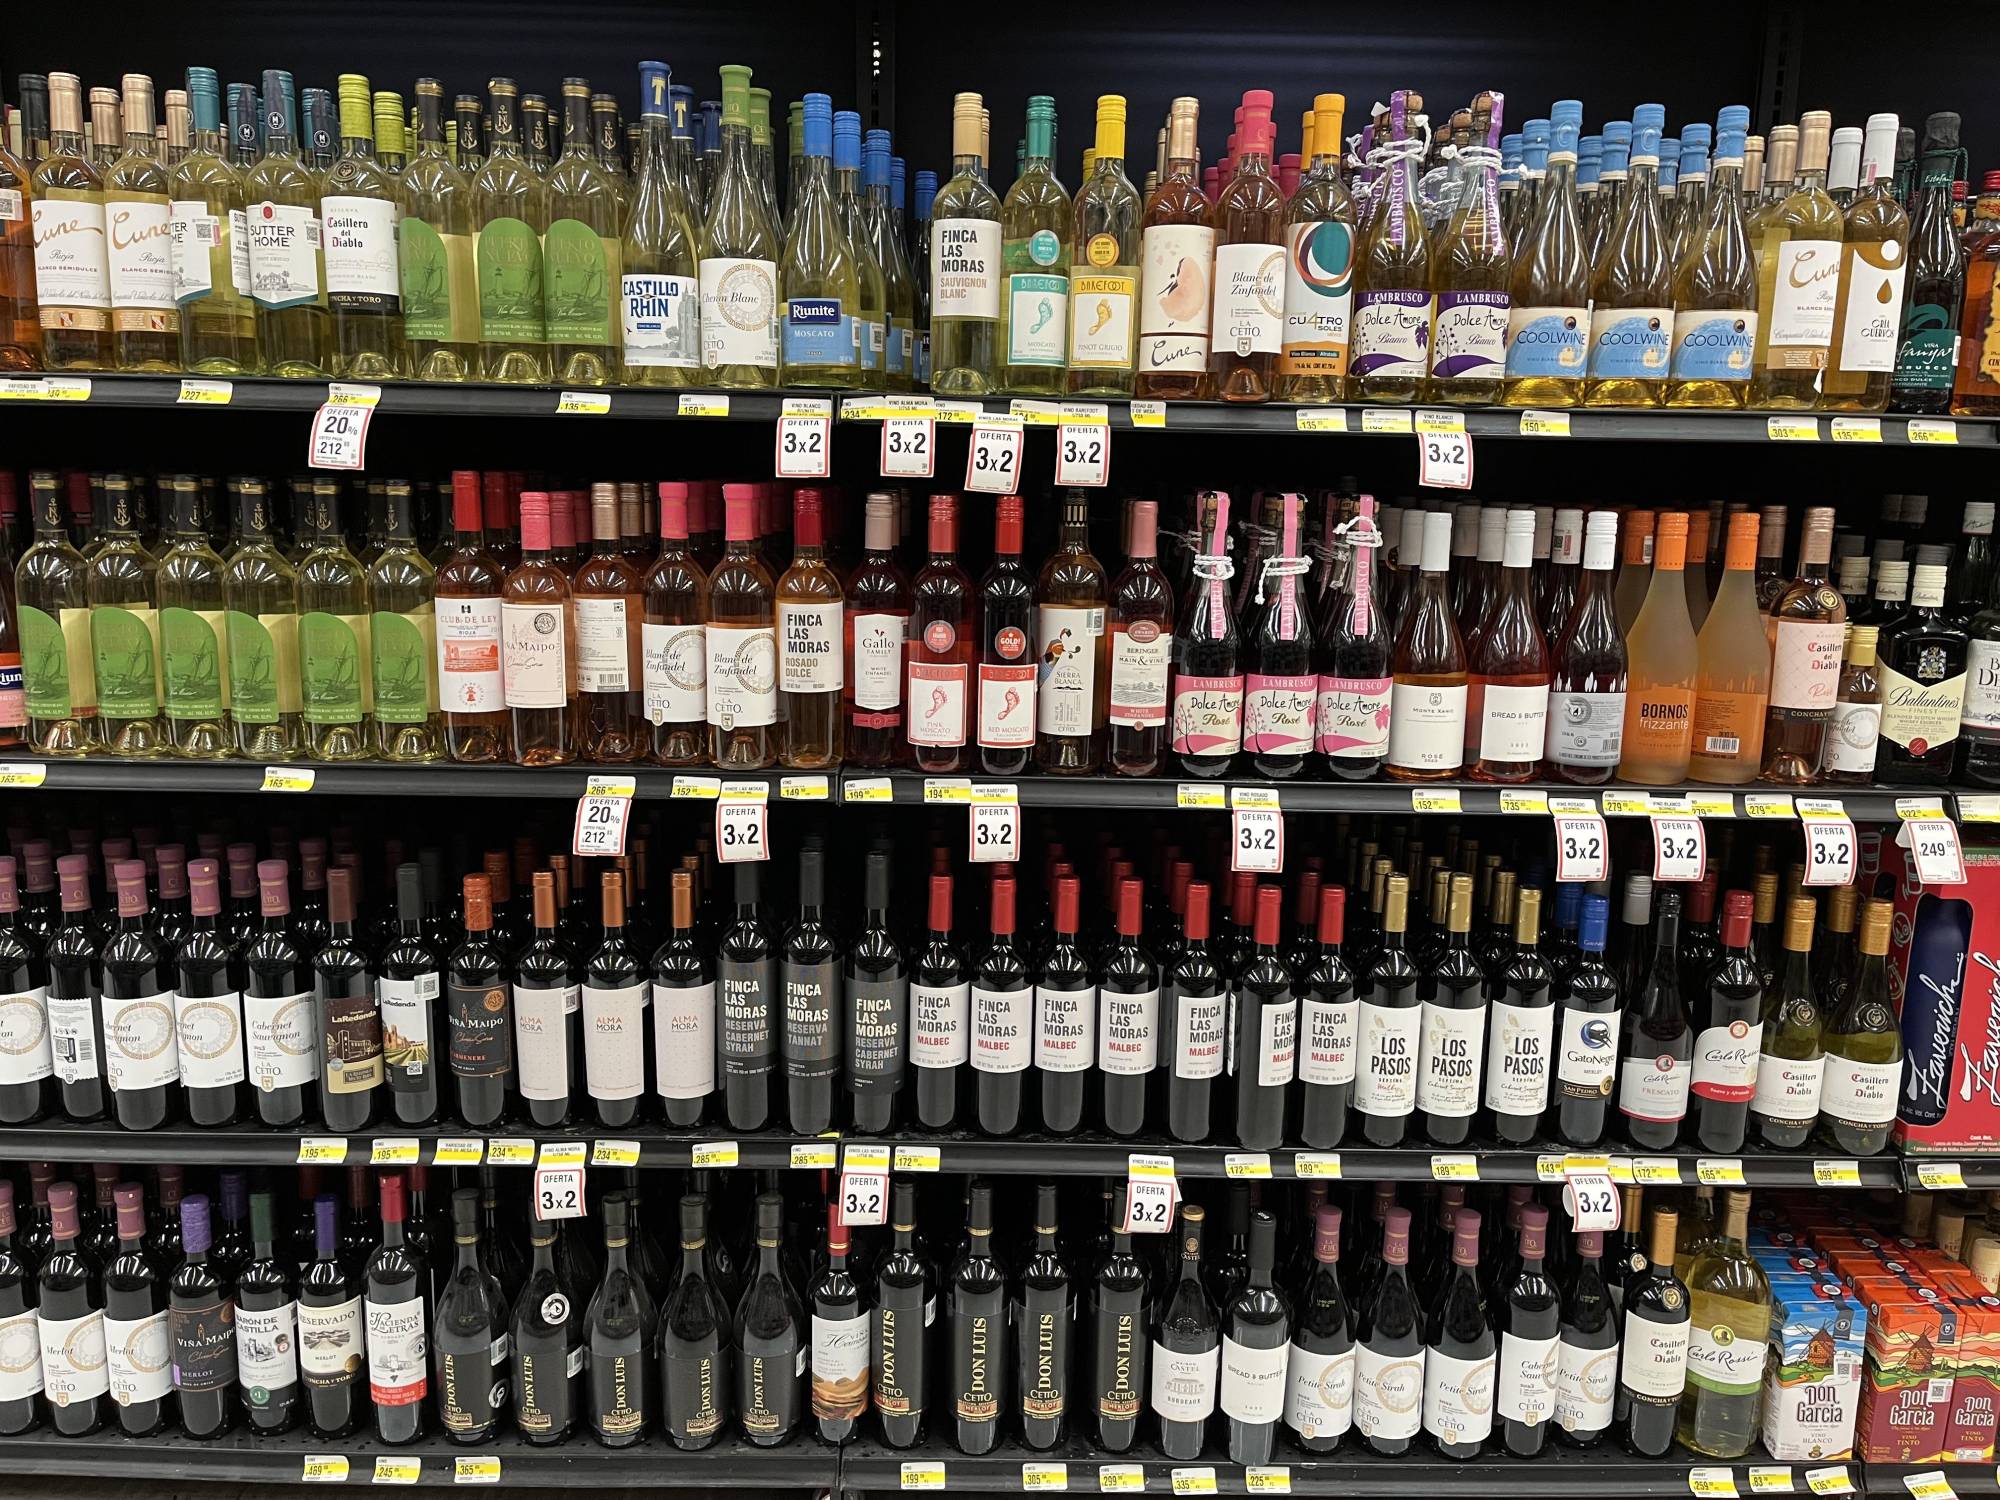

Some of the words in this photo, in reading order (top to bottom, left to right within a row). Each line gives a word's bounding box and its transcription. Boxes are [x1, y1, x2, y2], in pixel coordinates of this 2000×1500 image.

[328, 217, 368, 229] Casillero
[251, 225, 294, 236] SUTTER
[942, 230, 977, 243] FINCA
[255, 237, 289, 247] HOME
[333, 238, 363, 247] Diablo
[942, 245, 962, 257] LAS
[941, 260, 984, 272] MORAS
[940, 277, 986, 288] SAUVIGNON
[1080, 281, 1125, 291] BAREFOOT
[624, 281, 678, 297] CASTILLO
[941, 289, 966, 299] BLANC
[1368, 293, 1422, 302] LAMBRUSCO
[1457, 294, 1508, 304] LAMBRUSCO
[630, 298, 668, 318] RHIN
[793, 304, 834, 318] Riunite
[1365, 308, 1391, 325] Dolce
[1394, 307, 1421, 325] Amore
[794, 330, 834, 338] MOSCATO
[1517, 331, 1585, 345] COOLWINE
[1600, 332, 1669, 346] COOLWINE
[1684, 333, 1753, 348] COOLWINE
[327, 408, 359, 416] OFERTA
[980, 432, 1012, 441] OFERTA
[787, 614, 822, 626] FINCA
[787, 629, 808, 639] LAS
[788, 641, 829, 653] MORAS
[863, 638, 894, 649] Gallo
[786, 658, 818, 667] ROSADO
[714, 666, 756, 676] Zinfandel
[786, 669, 811, 677] DULCE
[1193, 680, 1241, 688] LAMBRUSCO
[1263, 678, 1313, 688] LAMBRUSCO
[1329, 680, 1381, 690] LAMBRUSCO
[1192, 692, 1216, 709] Dolce
[1219, 693, 1240, 712] Amore
[1261, 691, 1287, 708] Dolce
[1291, 693, 1311, 711] Amore
[1327, 692, 1352, 710] Dolce
[1355, 695, 1380, 714] Amore
[1887, 687, 1958, 709] Ballantine's
[1641, 703, 1688, 718] BORNOS
[1639, 718, 1688, 730] frizzante
[1242, 813, 1272, 821] OFERTA
[1814, 827, 1844, 835] OFERTA
[725, 980, 759, 993] FINCA
[787, 983, 821, 995] FINCA
[725, 993, 745, 1005] LAS
[787, 996, 807, 1008] LAS
[918, 996, 950, 1008] FINCA
[856, 999, 891, 1012] FINCA
[978, 1000, 1010, 1013] FINCA
[1045, 1000, 1077, 1011] FINCA
[1110, 1002, 1143, 1015] FINCA
[332, 1011, 376, 1023] LaRedonda
[726, 1006, 766, 1019] MORAS
[787, 1008, 829, 1022] MORAS
[856, 1012, 877, 1024] LAS
[918, 1008, 937, 1019] LAS
[978, 1011, 997, 1024] LAS
[1044, 1012, 1064, 1023] LAS
[1191, 1006, 1220, 1019] FINCA
[1313, 1012, 1346, 1024] FINCA
[252, 1021, 292, 1030] Cabernet
[596, 1016, 622, 1024] ALMA
[671, 1022, 698, 1030] MORA
[726, 1020, 766, 1030] RESERVA
[918, 1020, 956, 1032] MORAS
[1110, 1015, 1130, 1026] LAS
[1190, 1020, 1210, 1031] LAS
[787, 1022, 827, 1033] RESERVA
[856, 1023, 897, 1037] MORAS
[978, 1025, 1017, 1037] MORAS
[1044, 1024, 1083, 1036] MORAS
[1109, 1027, 1148, 1039] MORAS
[1312, 1025, 1334, 1036] LAS
[726, 1031, 769, 1041] CABERNET
[788, 1034, 822, 1045] TANNAT
[918, 1037, 949, 1045] MALBEC
[1190, 1028, 1222, 1043] MORAS
[726, 1041, 754, 1052] SYRAH
[855, 1037, 895, 1047] RESERVA
[978, 1039, 1009, 1050] MALBEC
[1044, 1040, 1076, 1049] MALBEC
[1109, 1042, 1141, 1052] MALBEC
[1312, 1037, 1350, 1048] MORAS
[1381, 1037, 1405, 1054] LOS
[1442, 1039, 1466, 1056] LOS
[1515, 1037, 1539, 1054] LOS
[855, 1048, 898, 1058] CABERNET
[1189, 1045, 1218, 1056] MALBEC
[1311, 1052, 1344, 1062] MALBEC
[855, 1060, 883, 1069] SYRAH
[1371, 1056, 1410, 1075] PASOS
[1432, 1059, 1472, 1077] PASOS
[1504, 1056, 1543, 1074] PASOS
[1851, 1074, 1888, 1083] Casillero
[1855, 1090, 1883, 1099] Diablo
[544, 1175, 573, 1183] OFERTA
[850, 1178, 878, 1186] OFERTA
[1136, 1186, 1165, 1196] OFERTA
[883, 1310, 894, 1349] LUIS
[1039, 1314, 1053, 1352] LUIS
[1117, 1316, 1132, 1352] LUIS
[972, 1318, 986, 1354] LUIS
[46, 1345, 73, 1355] Merlot
[110, 1345, 134, 1355] Merlot
[883, 1350, 894, 1385] DON
[1039, 1353, 1051, 1388] DON
[1116, 1354, 1129, 1390] DON
[972, 1356, 985, 1392] DON
[1559, 1369, 1584, 1383] Petite
[1586, 1375, 1608, 1385] Sirah
[1298, 1375, 1322, 1389] Petite
[1323, 1380, 1346, 1390] Sirah
[1358, 1372, 1378, 1387] Petite
[1381, 1382, 1404, 1392] Sirah
[878, 1385, 902, 1397] CETTO
[1030, 1390, 1058, 1399] CETTO
[1440, 1382, 1465, 1395] Petite
[1466, 1385, 1488, 1395] Sirah
[964, 1393, 992, 1402] CETTO
[1107, 1391, 1135, 1400] CETTO
[1805, 1386, 1839, 1405] Don
[1965, 1396, 1992, 1413] Don
[1797, 1403, 1842, 1423] Garcia
[1890, 1406, 1934, 1426] Garcia
[1955, 1410, 1994, 1427] Garcia
